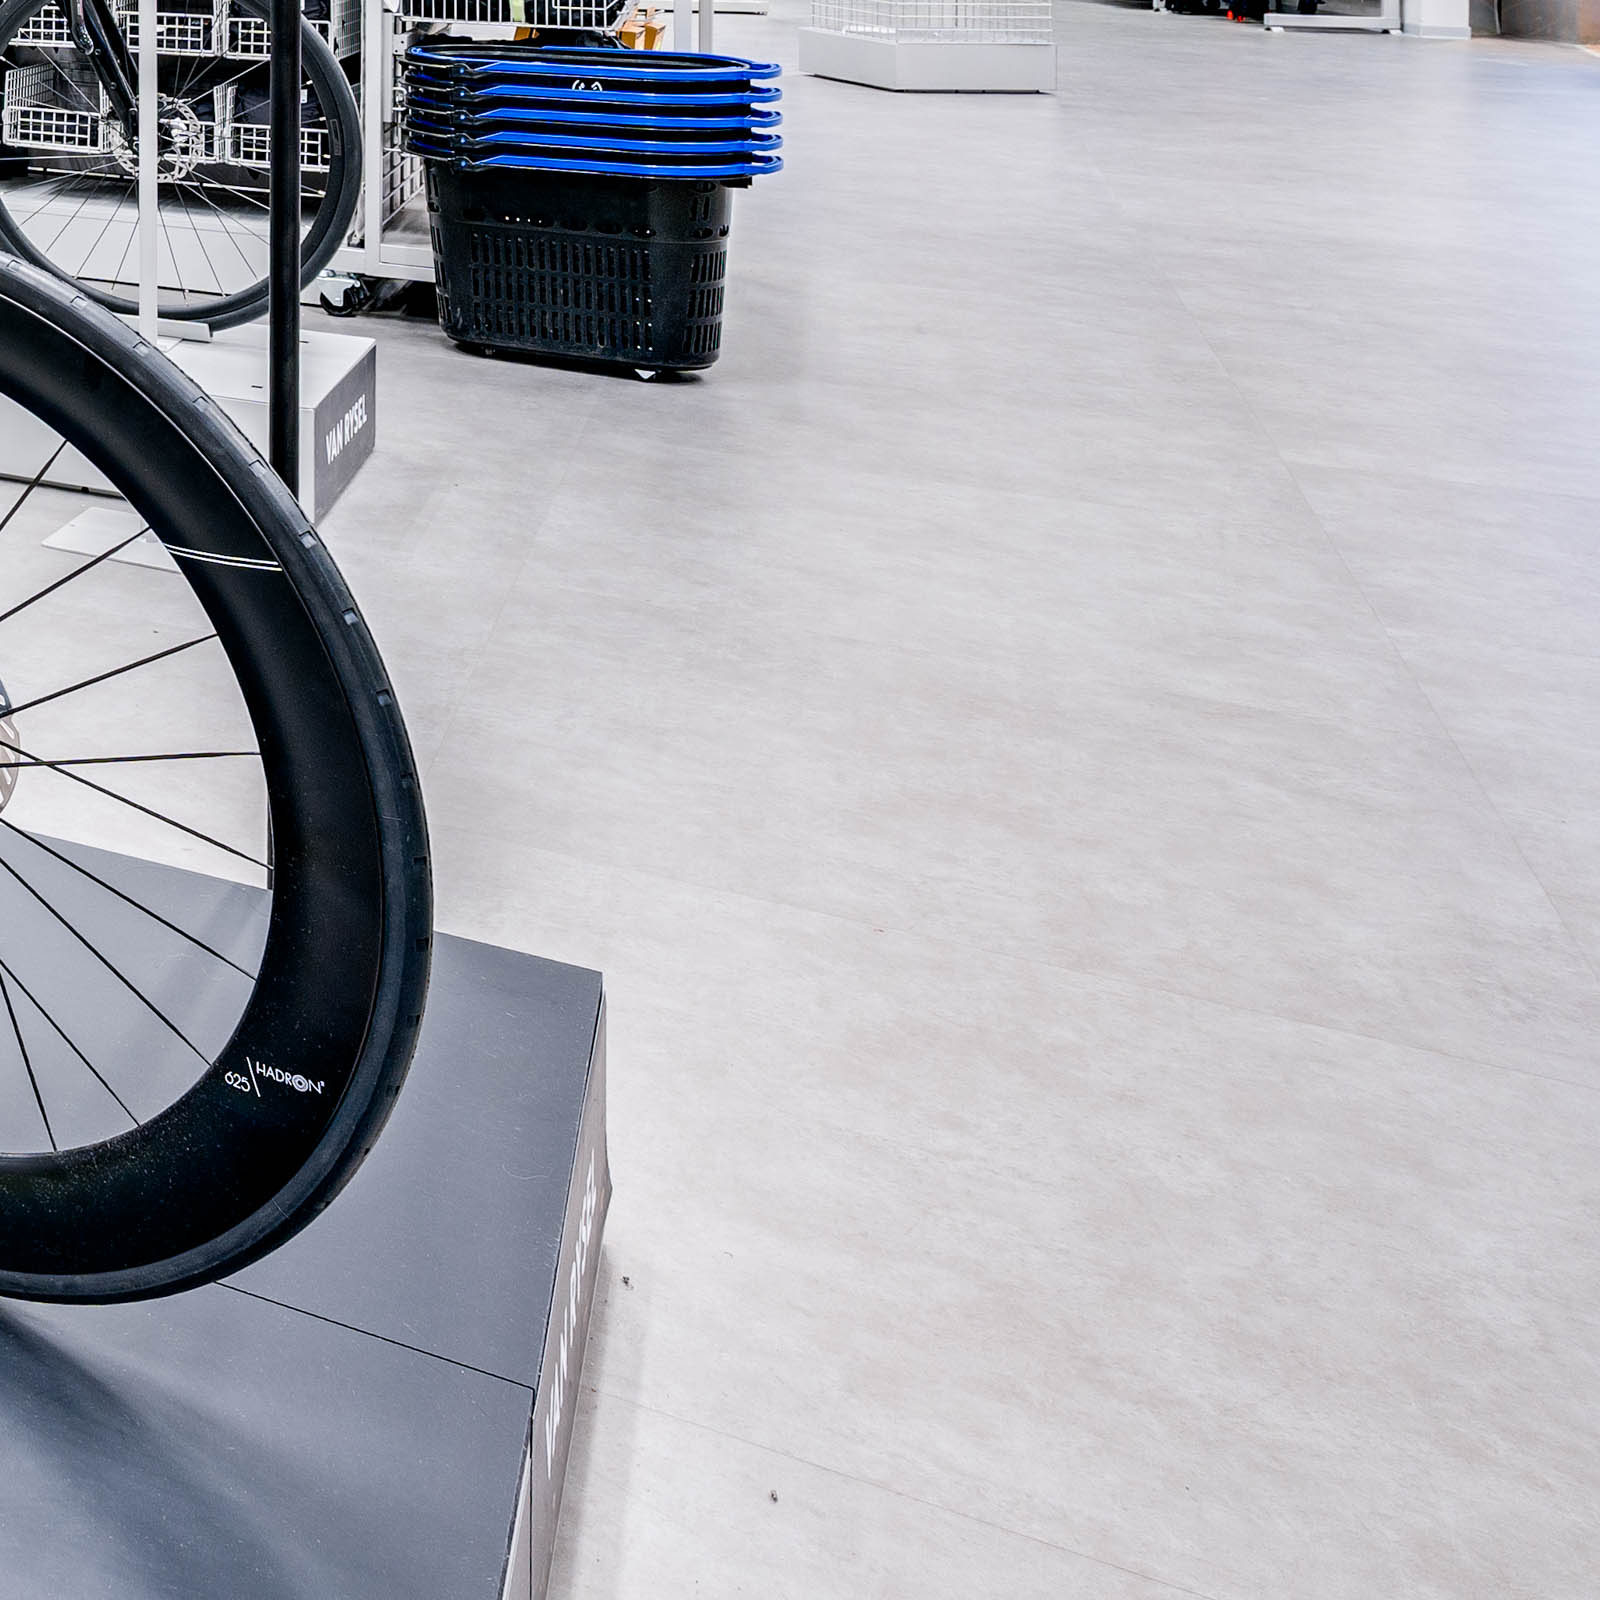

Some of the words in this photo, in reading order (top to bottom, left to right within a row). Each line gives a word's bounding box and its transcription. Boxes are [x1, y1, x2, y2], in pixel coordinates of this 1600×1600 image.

[325, 419, 344, 465] VAN
[344, 393, 368, 446] RYSEL
[224, 1071, 251, 1093] 625
